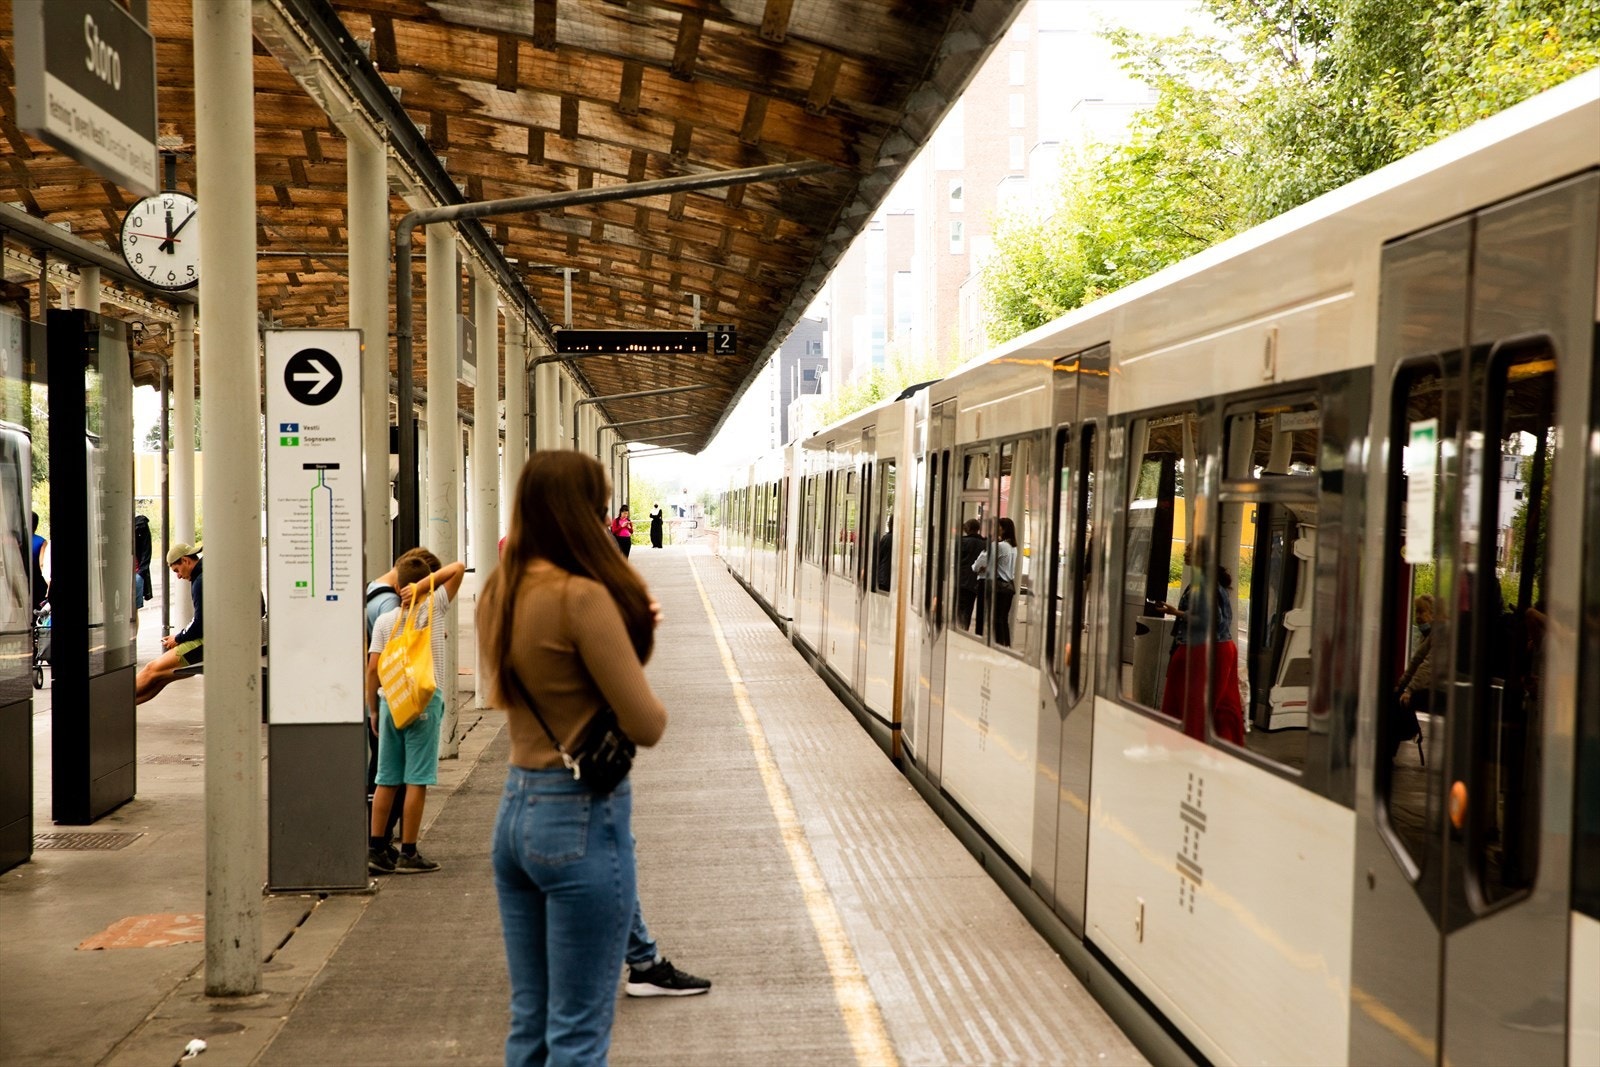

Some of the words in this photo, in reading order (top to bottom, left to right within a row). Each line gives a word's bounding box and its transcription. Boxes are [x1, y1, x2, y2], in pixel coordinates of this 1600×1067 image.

[84, 13, 121, 91] Storo
[146, 203, 156, 215] 11
[163, 198, 174, 210] 12
[132, 216, 143, 228] 10
[128, 234, 138, 246] 9
[134, 252, 143, 264] 8
[148, 265, 157, 277] 7
[167, 270, 176, 281] 6
[186, 264, 195, 277] 5
[720, 333, 730, 348] 2
[286, 424, 293, 432] 4
[286, 436, 293, 446] 5
[303, 436, 336, 444] Sognsvann
